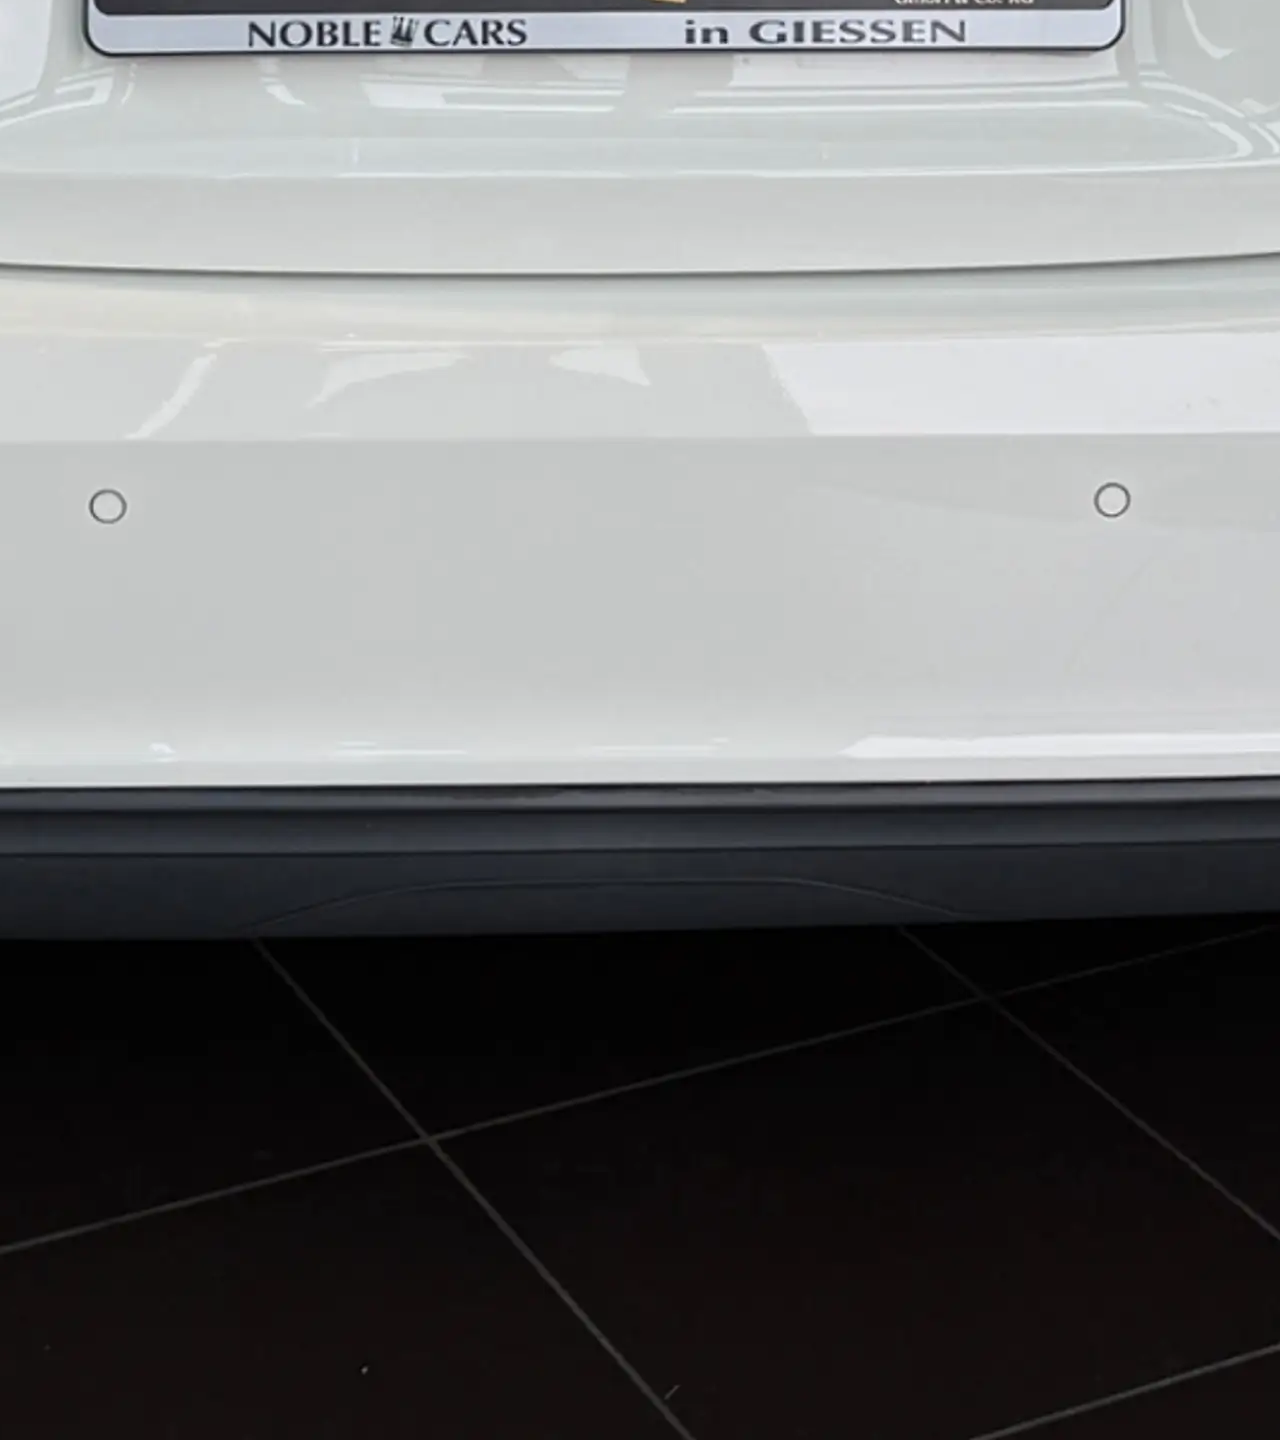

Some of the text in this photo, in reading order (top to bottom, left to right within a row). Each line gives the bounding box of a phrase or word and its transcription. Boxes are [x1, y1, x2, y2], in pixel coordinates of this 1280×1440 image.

[247, 19, 967, 48] NOBLE CARS in GIESSEN
